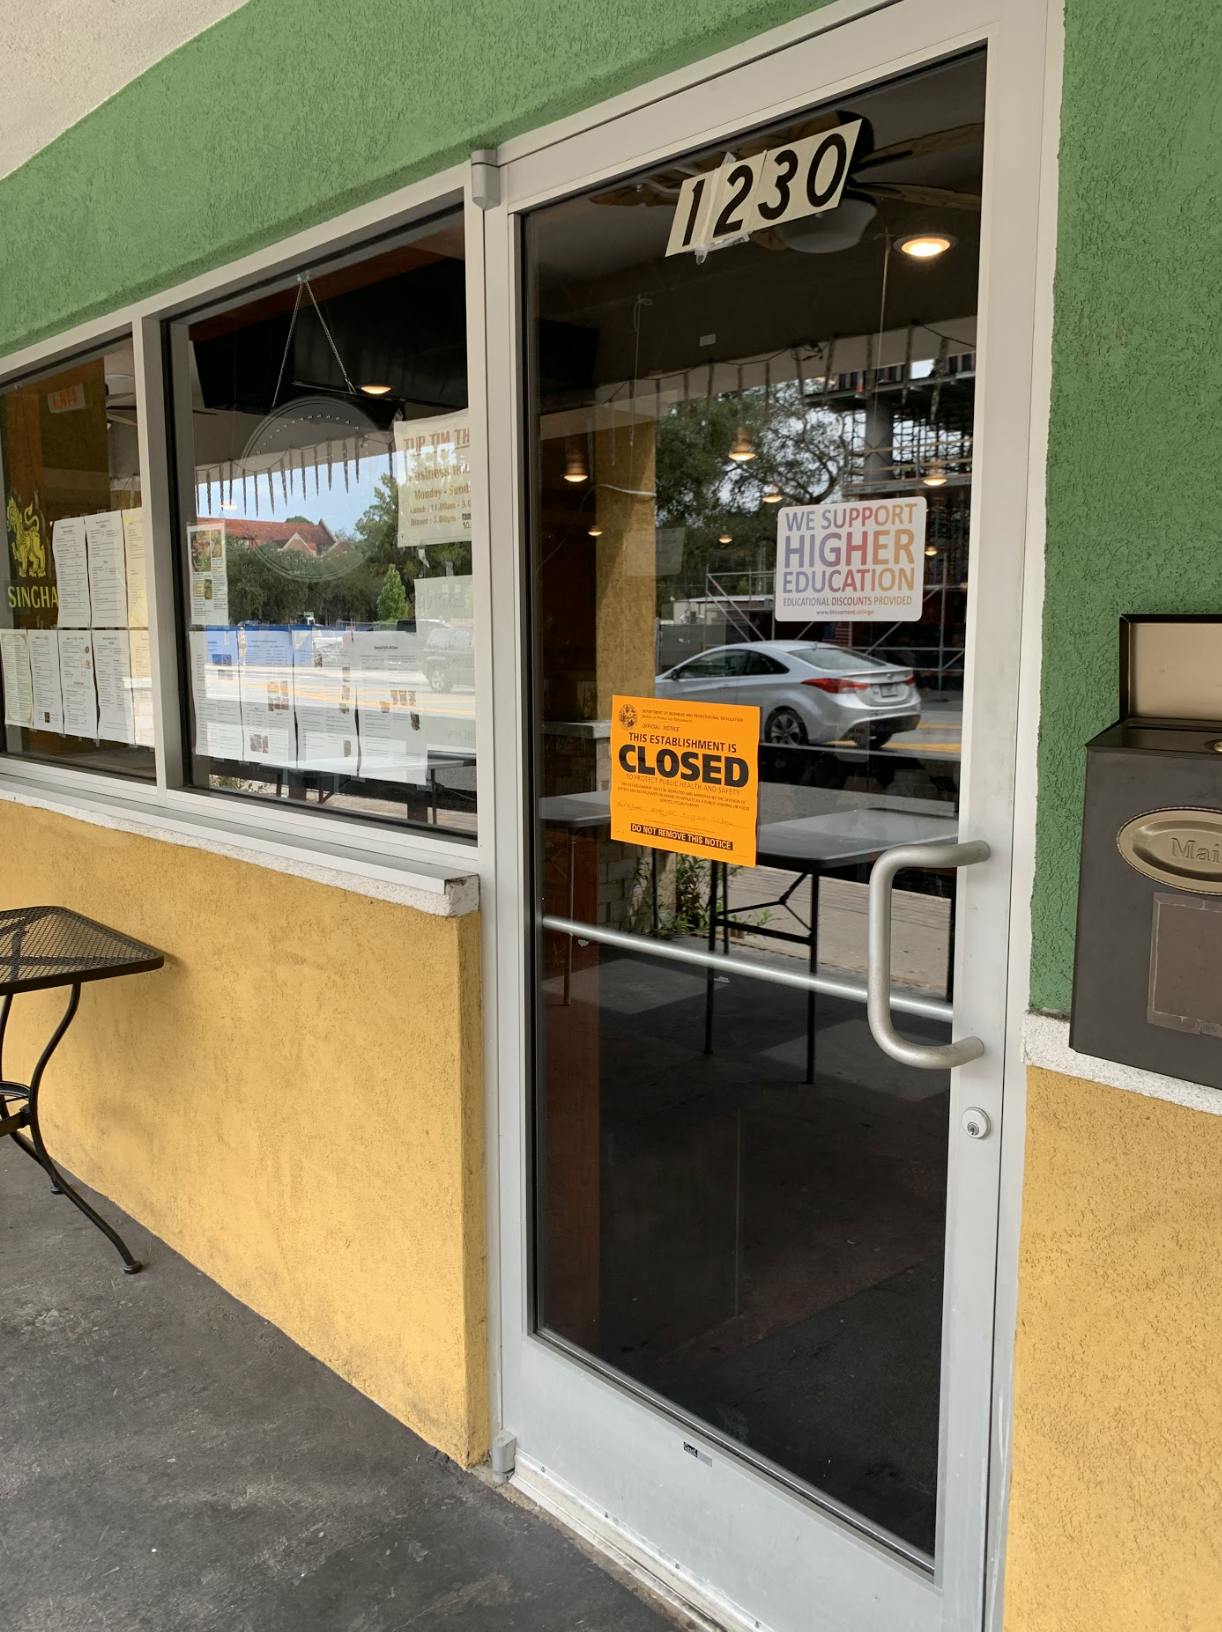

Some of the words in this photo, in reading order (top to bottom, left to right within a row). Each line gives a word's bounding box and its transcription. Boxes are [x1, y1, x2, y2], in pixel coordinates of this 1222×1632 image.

[682, 133, 847, 247] 1230
[785, 510, 815, 532] WE
[821, 503, 918, 530] SUPPORT
[784, 528, 915, 569] HIGHER
[783, 567, 915, 594] EDUCATION
[7, 585, 59, 608] SINGHA
[783, 597, 830, 607] EDUCATIONAL
[831, 596, 872, 606] DISCOUNTS
[873, 595, 912, 606] PROVIDED
[629, 732, 647, 743] THIS
[650, 734, 726, 752] ESTABLISHMENT
[728, 743, 737, 753] IS
[618, 744, 749, 788] CLOSED
[679, 781, 702, 790] HEALTH
[704, 784, 717, 792] AND
[718, 787, 741, 796] SAFETY
[631, 824, 642, 832] DO
[643, 825, 656, 835] NOT
[658, 828, 686, 841] REMOVE
[687, 834, 703, 844] THIS
[704, 837, 731, 850] NOTICE
